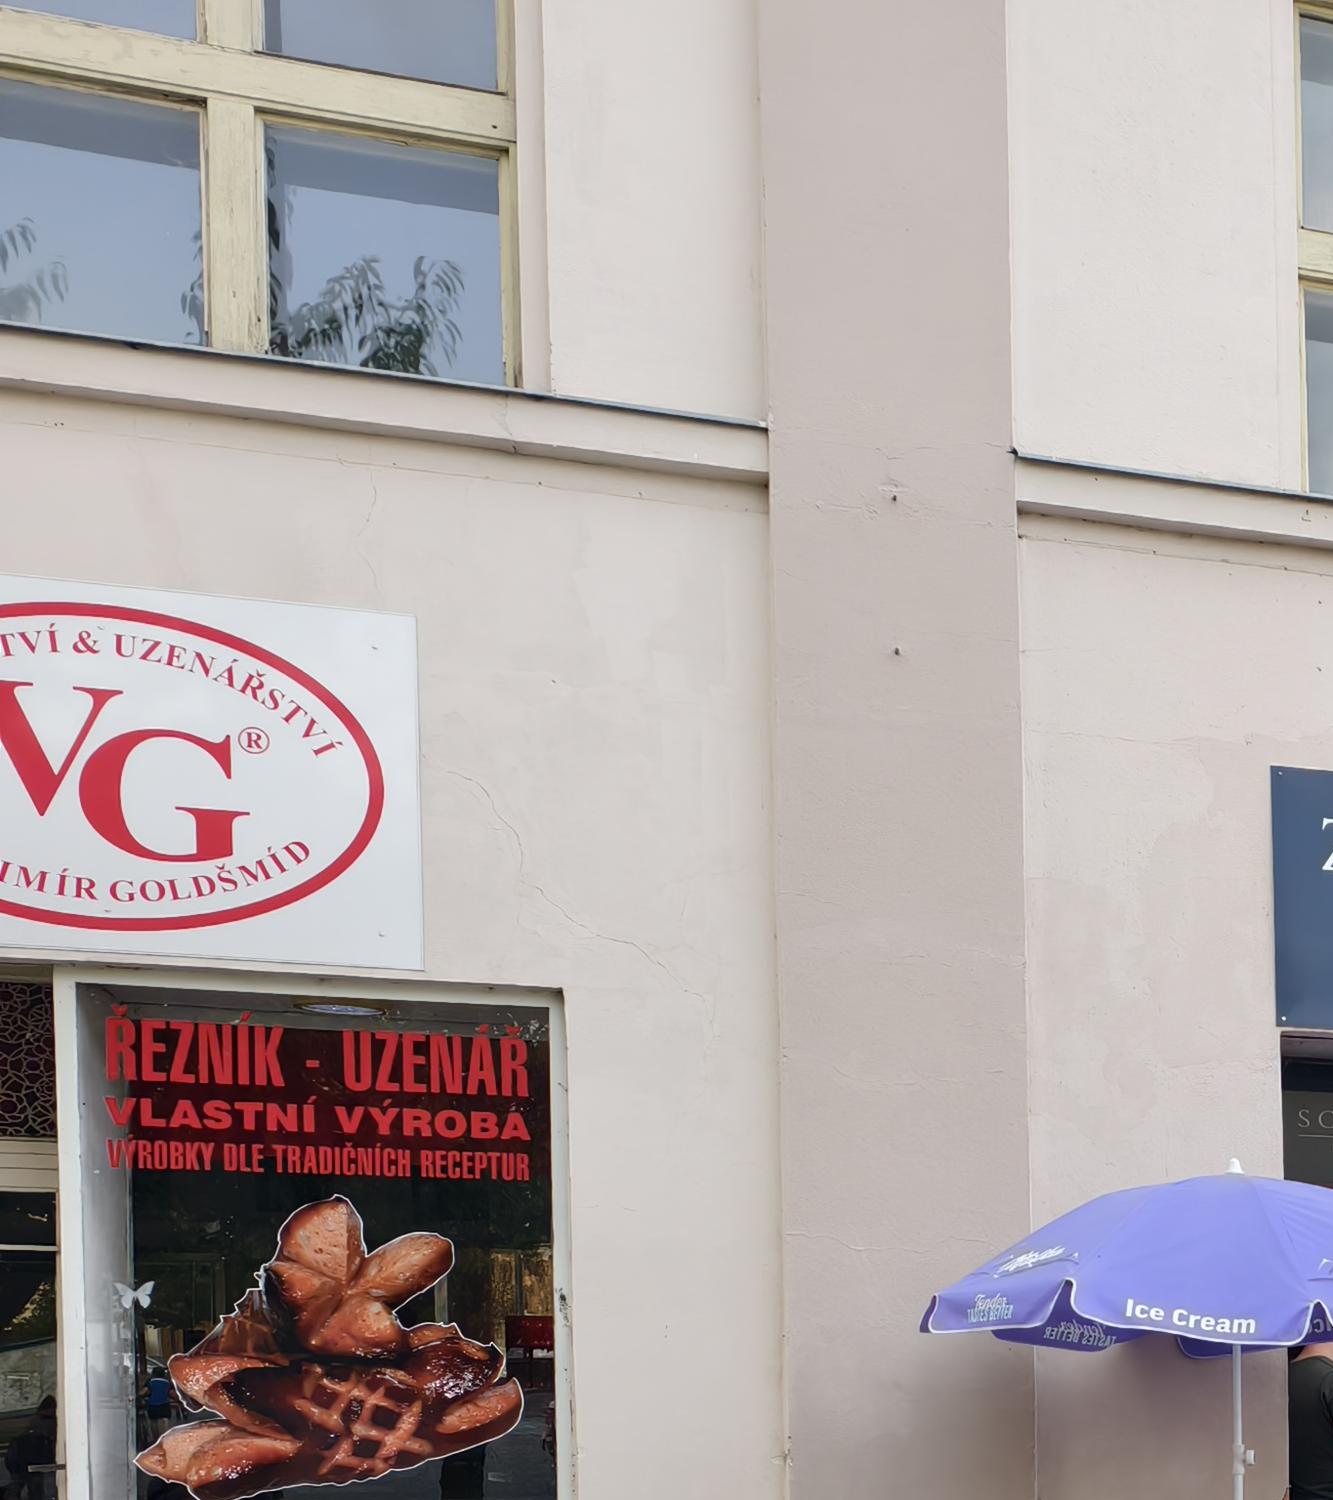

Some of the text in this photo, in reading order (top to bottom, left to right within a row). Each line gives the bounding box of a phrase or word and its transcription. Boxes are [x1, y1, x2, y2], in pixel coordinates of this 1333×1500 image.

[73, 630, 100, 654] &
[114, 631, 345, 758] UZENÁŘSTVÍ
[109, 839, 311, 903] GOLDŠMÍD
[105, 1003, 285, 1087] ŘEZNÍK
[342, 1023, 529, 1097] UZENÁŘ
[104, 1096, 531, 1141] VLASTNÍ VÝROBA
[106, 1134, 530, 1181] VÝROBKY DLE TRADIČNÍCH RECEPTUR
[1125, 1298, 1256, 1334] Ice Cream
